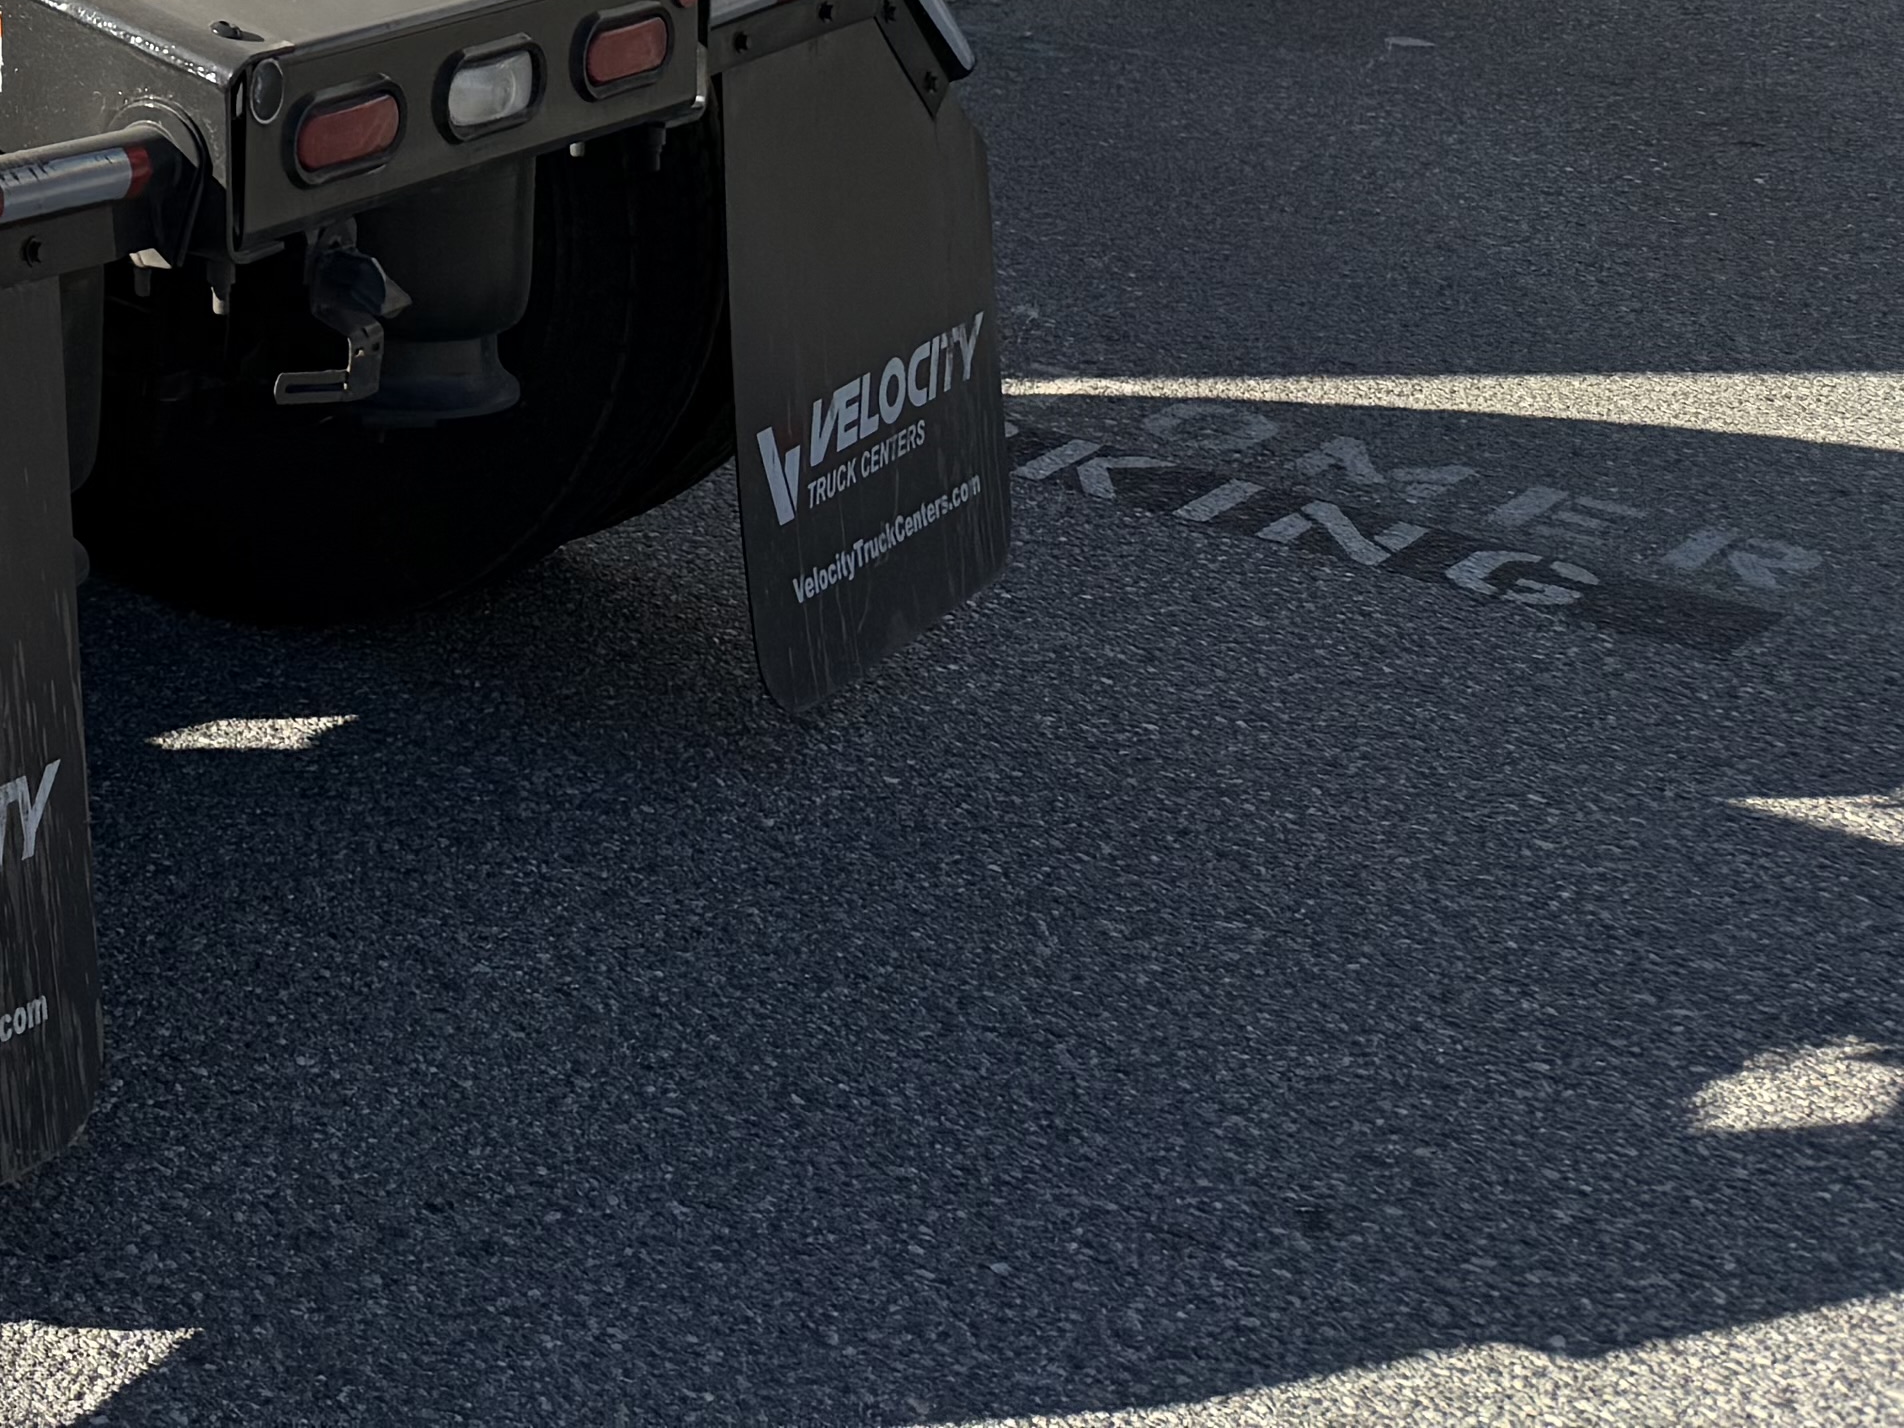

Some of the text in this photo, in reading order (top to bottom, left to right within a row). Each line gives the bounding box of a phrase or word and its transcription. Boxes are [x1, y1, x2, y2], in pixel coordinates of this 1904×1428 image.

[807, 419, 926, 510] TRUCK CENTERS
[810, 311, 985, 468] VELOCITY
[792, 472, 982, 605] VelocityTruckCenters.com
[1004, 424, 1600, 606] KING
[1144, 401, 1824, 590] OMER
